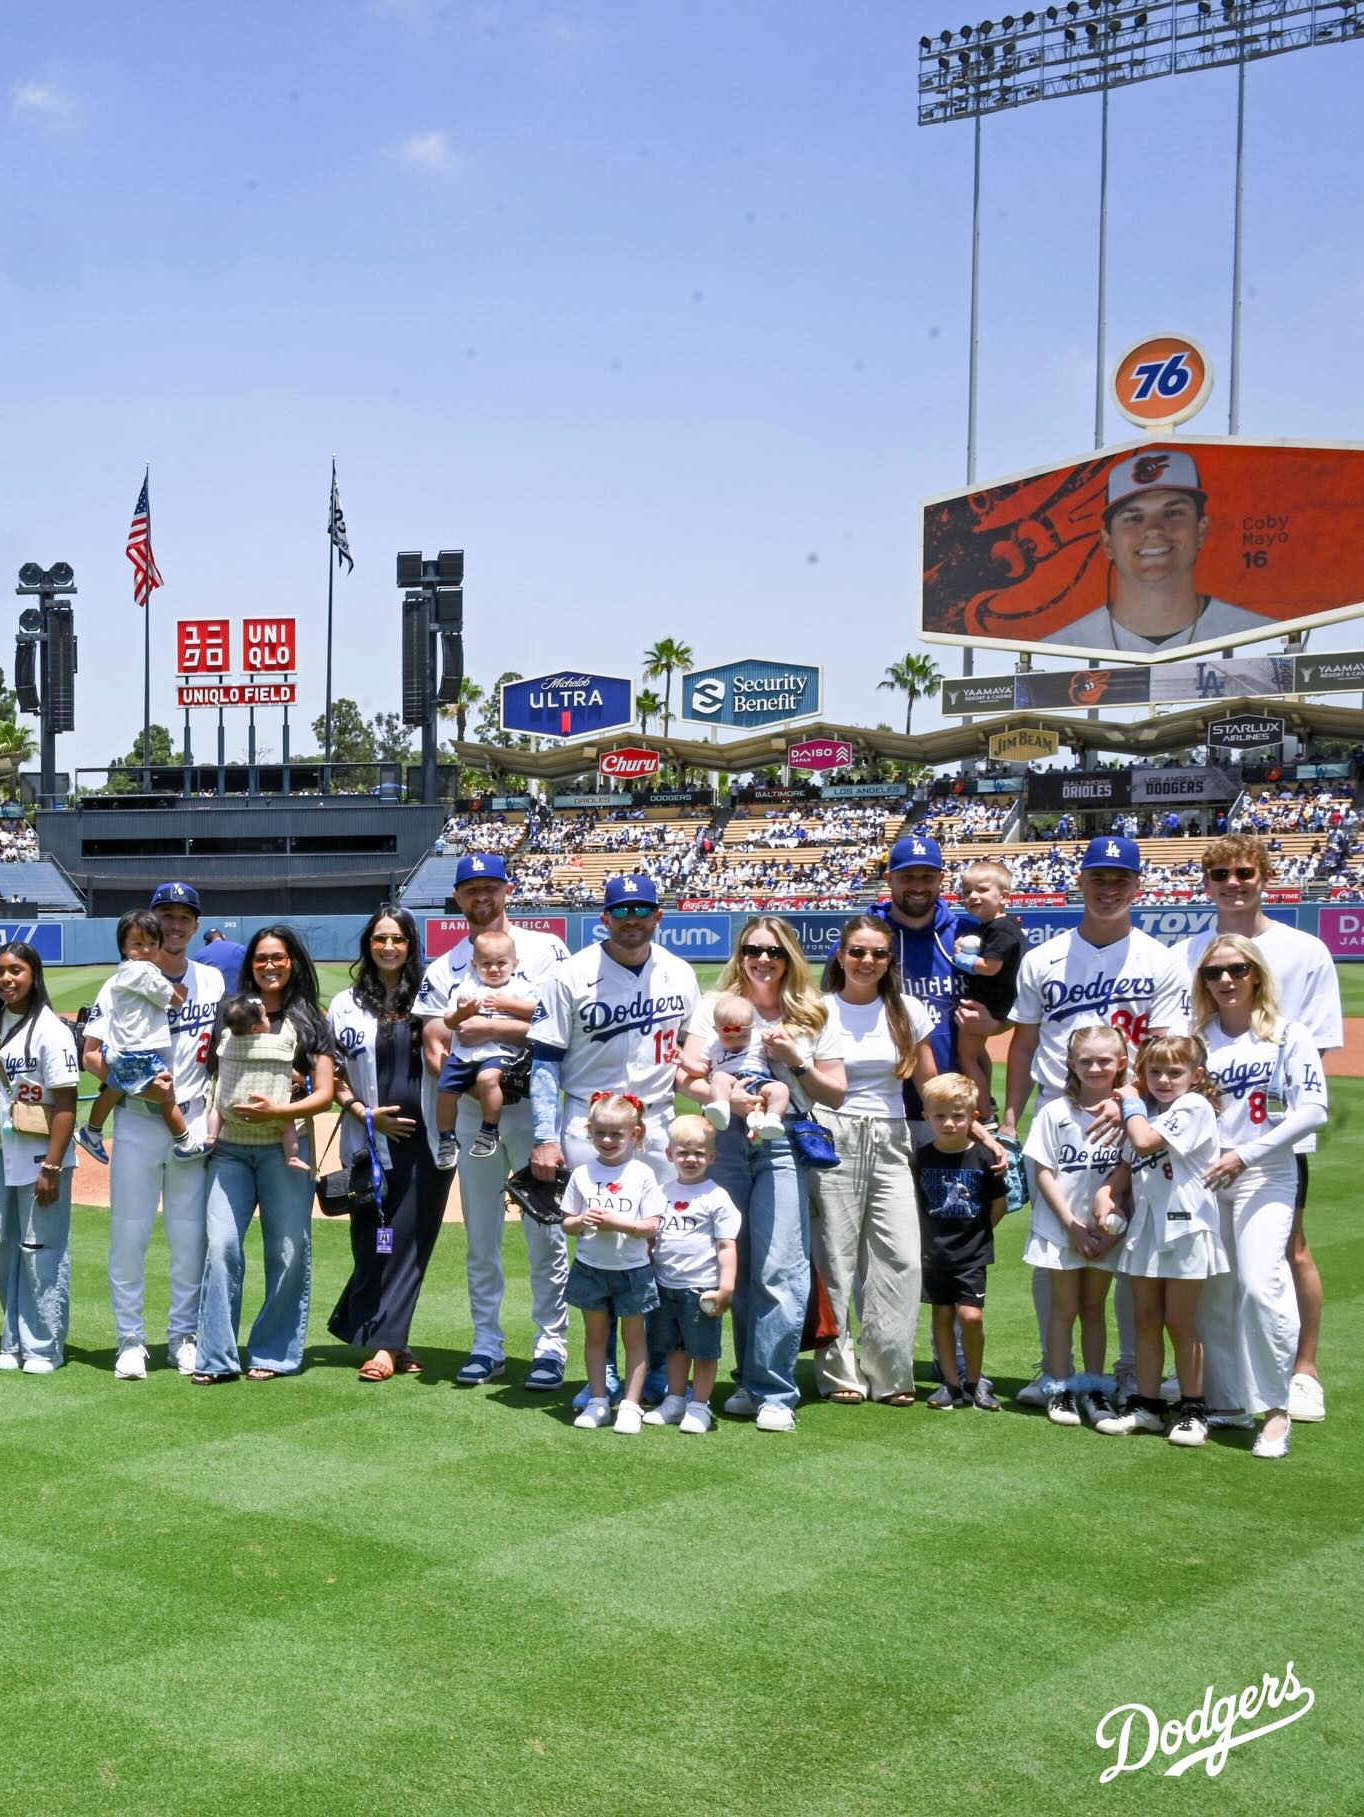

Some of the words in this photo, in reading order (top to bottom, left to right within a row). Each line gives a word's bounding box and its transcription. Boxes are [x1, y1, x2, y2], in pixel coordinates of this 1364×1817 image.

[1131, 352, 1192, 402] 76
[1243, 515, 1289, 531] Coby
[1243, 532, 1289, 546] Mayo
[1243, 551, 1268, 569] 16
[184, 626, 222, 644] ユニ
[248, 624, 286, 643] UNI
[248, 646, 290, 668] QLO
[541, 675, 592, 690] Michelob
[733, 673, 808, 694] Security
[183, 688, 239, 704] UNIQLO
[244, 687, 291, 702] FIELD
[529, 689, 604, 708] ULTRA
[733, 694, 797, 712] Benefit
[1212, 722, 1280, 735] STARLUX
[1223, 733, 1269, 742] AIRLINES
[993, 737, 1018, 756] JIM
[1019, 732, 1053, 753] BEAM
[602, 755, 657, 772] Churu
[755, 790, 805, 798] BALTIMORE
[834, 788, 853, 796] LOS
[856, 785, 900, 795] ANGELES
[1062, 785, 1112, 799] ORIOLES
[1146, 780, 1204, 795] DODGERS
[650, 793, 692, 802] DODGERS
[1042, 971, 1155, 1022] Dodgers
[580, 991, 685, 1042] Dodgers
[1303, 1064, 1322, 1093] LA
[18, 1083, 43, 1102] 29
[1247, 1091, 1267, 1125] 8
[588, 1198, 633, 1213] DAD
